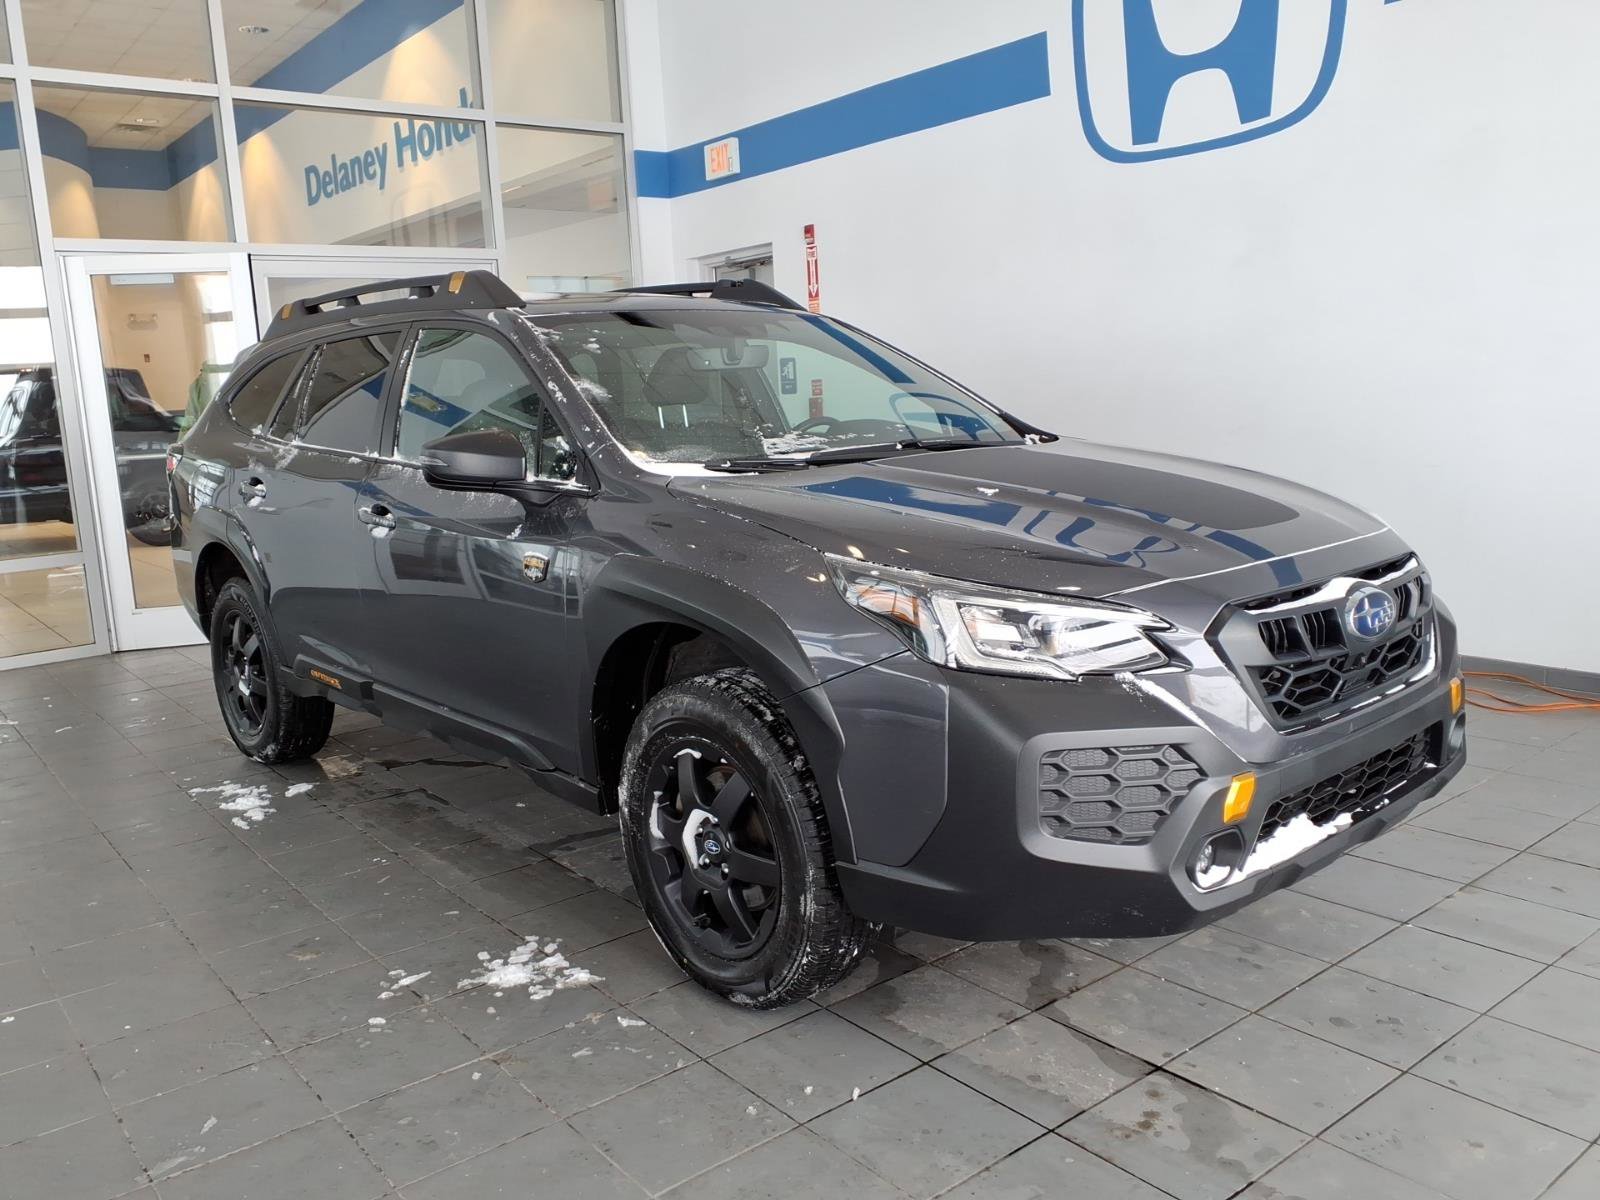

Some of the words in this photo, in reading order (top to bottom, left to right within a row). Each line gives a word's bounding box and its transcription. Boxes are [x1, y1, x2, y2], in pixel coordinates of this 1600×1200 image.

[304, 142, 388, 206] Delaney
[394, 87, 476, 168] Hond
[710, 142, 729, 173] EXIT
